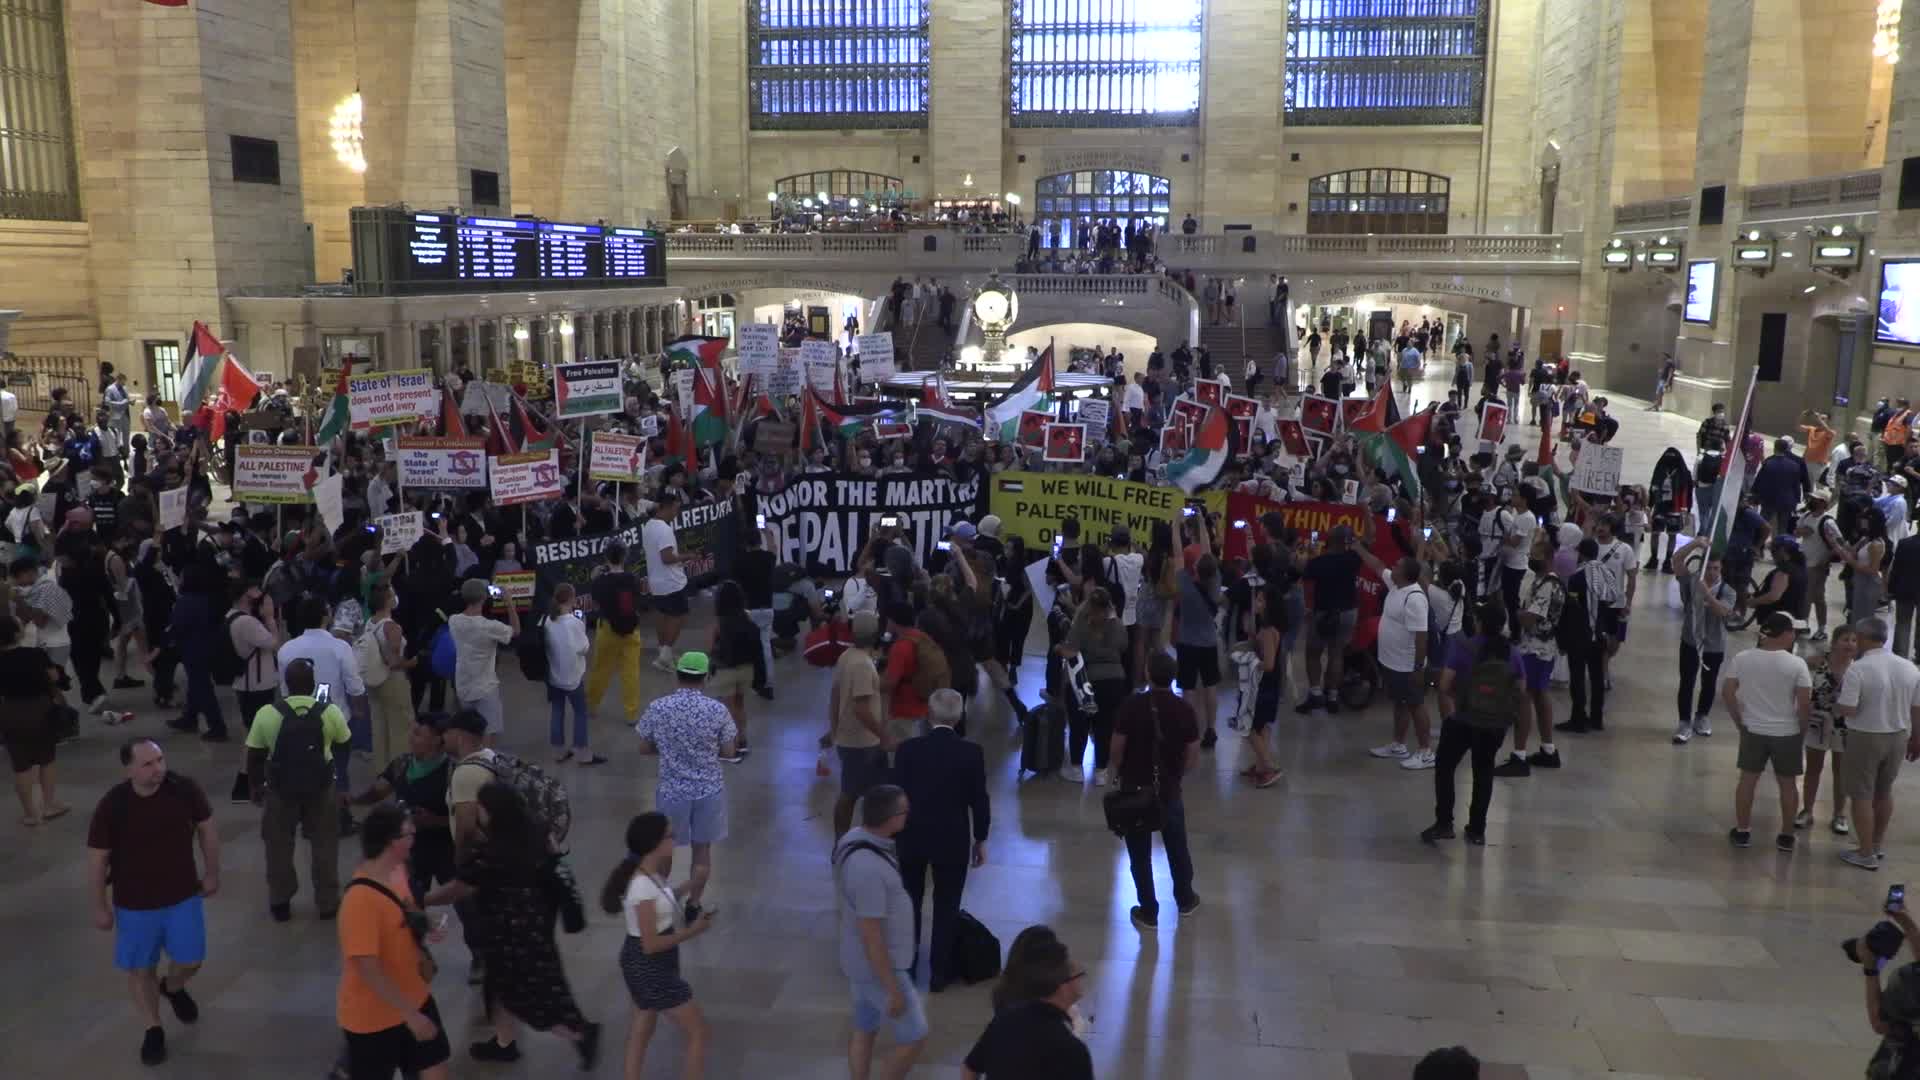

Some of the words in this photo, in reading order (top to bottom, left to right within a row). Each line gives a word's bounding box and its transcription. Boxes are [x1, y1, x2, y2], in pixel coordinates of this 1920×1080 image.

[566, 369, 582, 378] Free
[584, 367, 614, 376] Palestine
[351, 378, 377, 393] State
[379, 375, 390, 388] of
[352, 395, 373, 406] does
[375, 392, 392, 403] not
[369, 402, 394, 415] world
[413, 451, 429, 459] the
[240, 461, 256, 471] ALL
[258, 461, 305, 472] PALESTINE
[404, 459, 428, 468] State
[430, 459, 439, 468] of
[405, 477, 422, 485] And
[424, 476, 436, 485] its
[437, 476, 481, 485] Atrocities
[756, 479, 828, 518] HONOR
[835, 480, 877, 506] THE
[885, 472, 981, 507] MARTYRS
[1041, 479, 1069, 496] WE
[1075, 479, 1119, 501] WILL
[1123, 486, 1172, 509] FREE
[1016, 502, 1122, 526] PALESTINE
